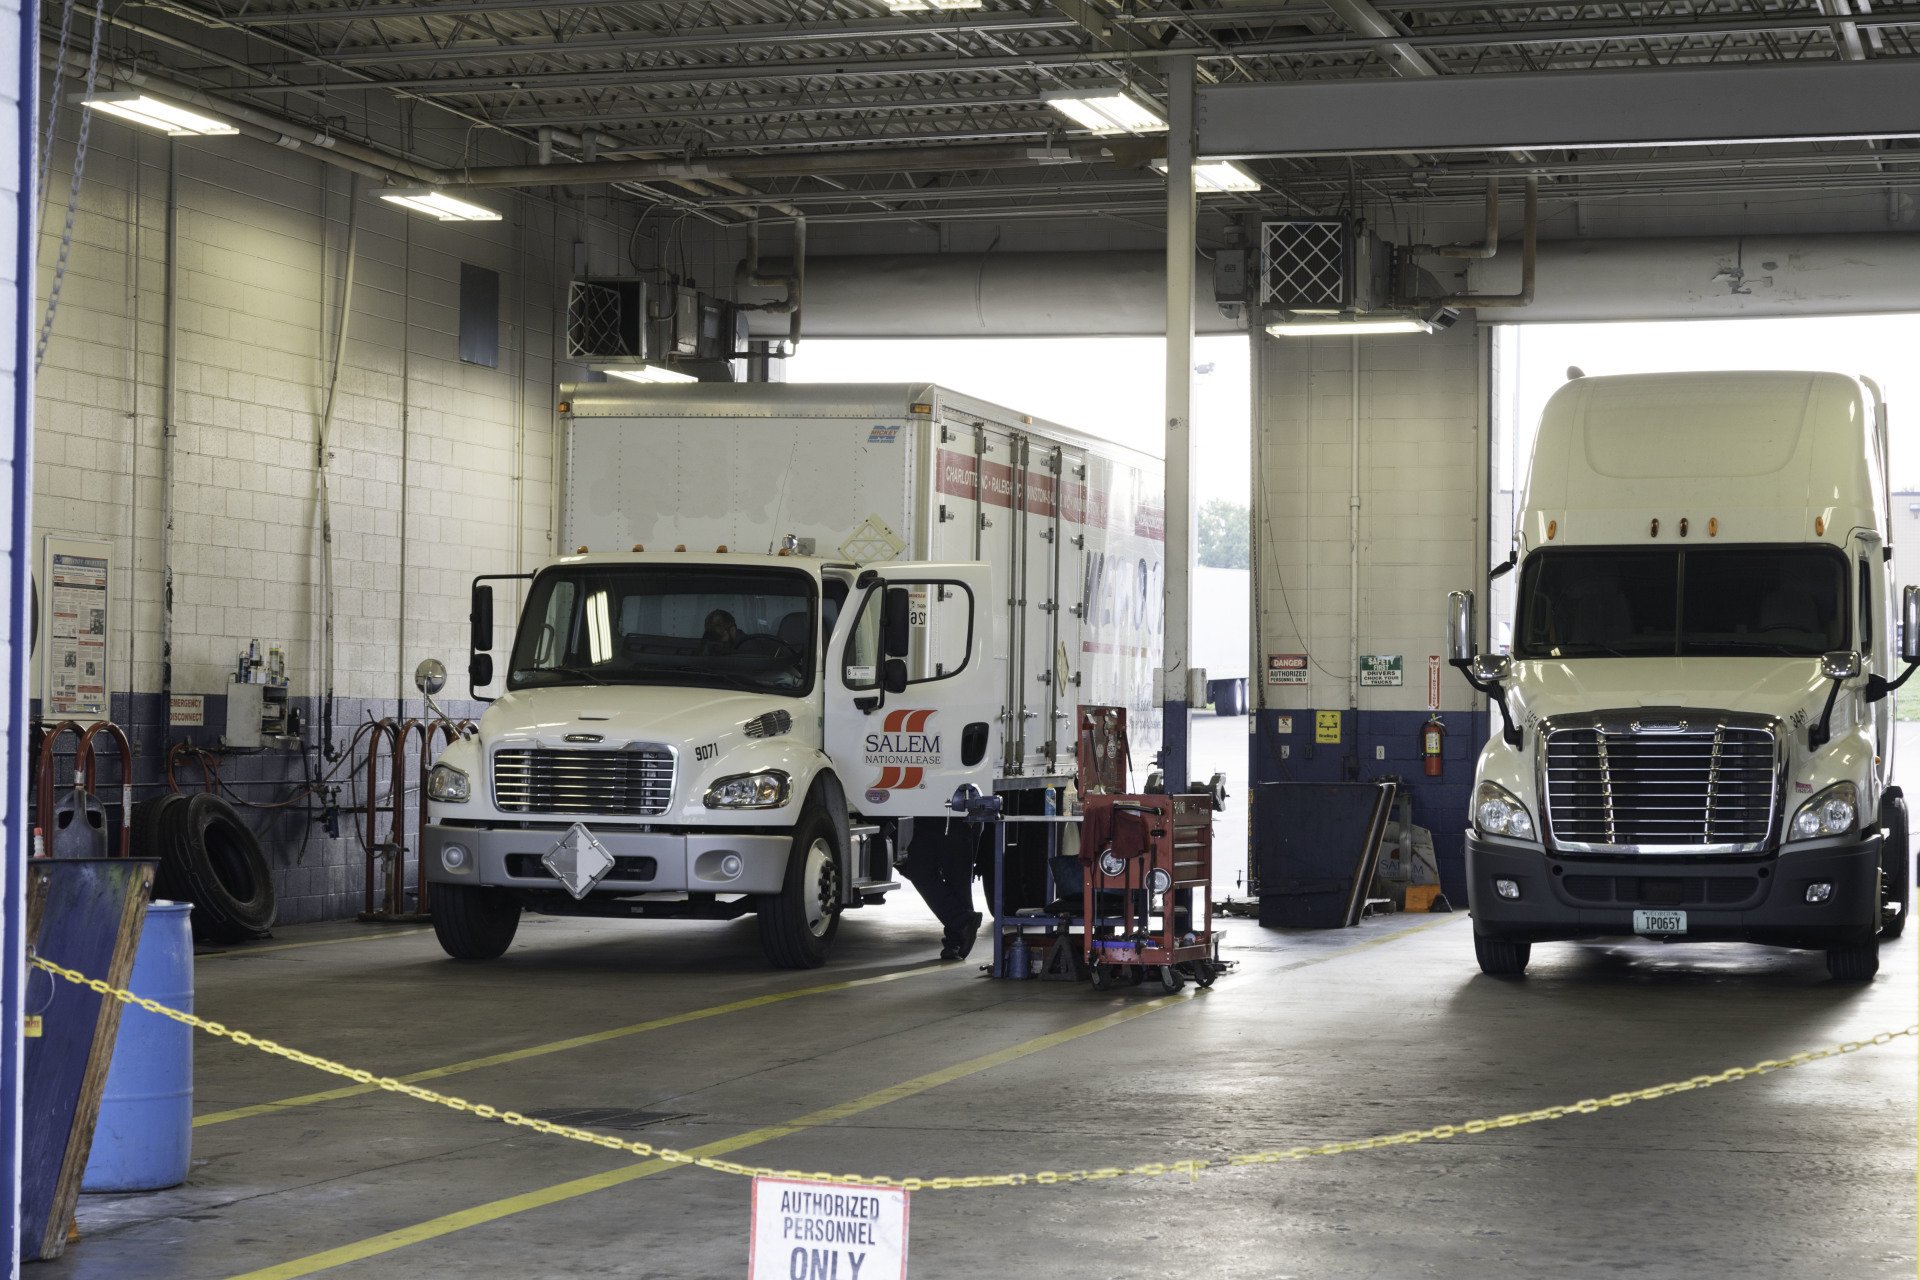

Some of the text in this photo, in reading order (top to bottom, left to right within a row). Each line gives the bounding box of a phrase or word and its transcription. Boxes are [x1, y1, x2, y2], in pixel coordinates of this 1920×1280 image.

[170, 699, 202, 708] EMERGENCY
[170, 713, 202, 721] DISCONNECT
[694, 743, 719, 762] 9071
[866, 734, 941, 753] SALEM
[865, 755, 941, 765] NATIONALEASE
[781, 1190, 880, 1219] AUTHORIZED
[783, 1216, 876, 1246] PERSONNEL
[790, 1246, 866, 1280] ONLY
